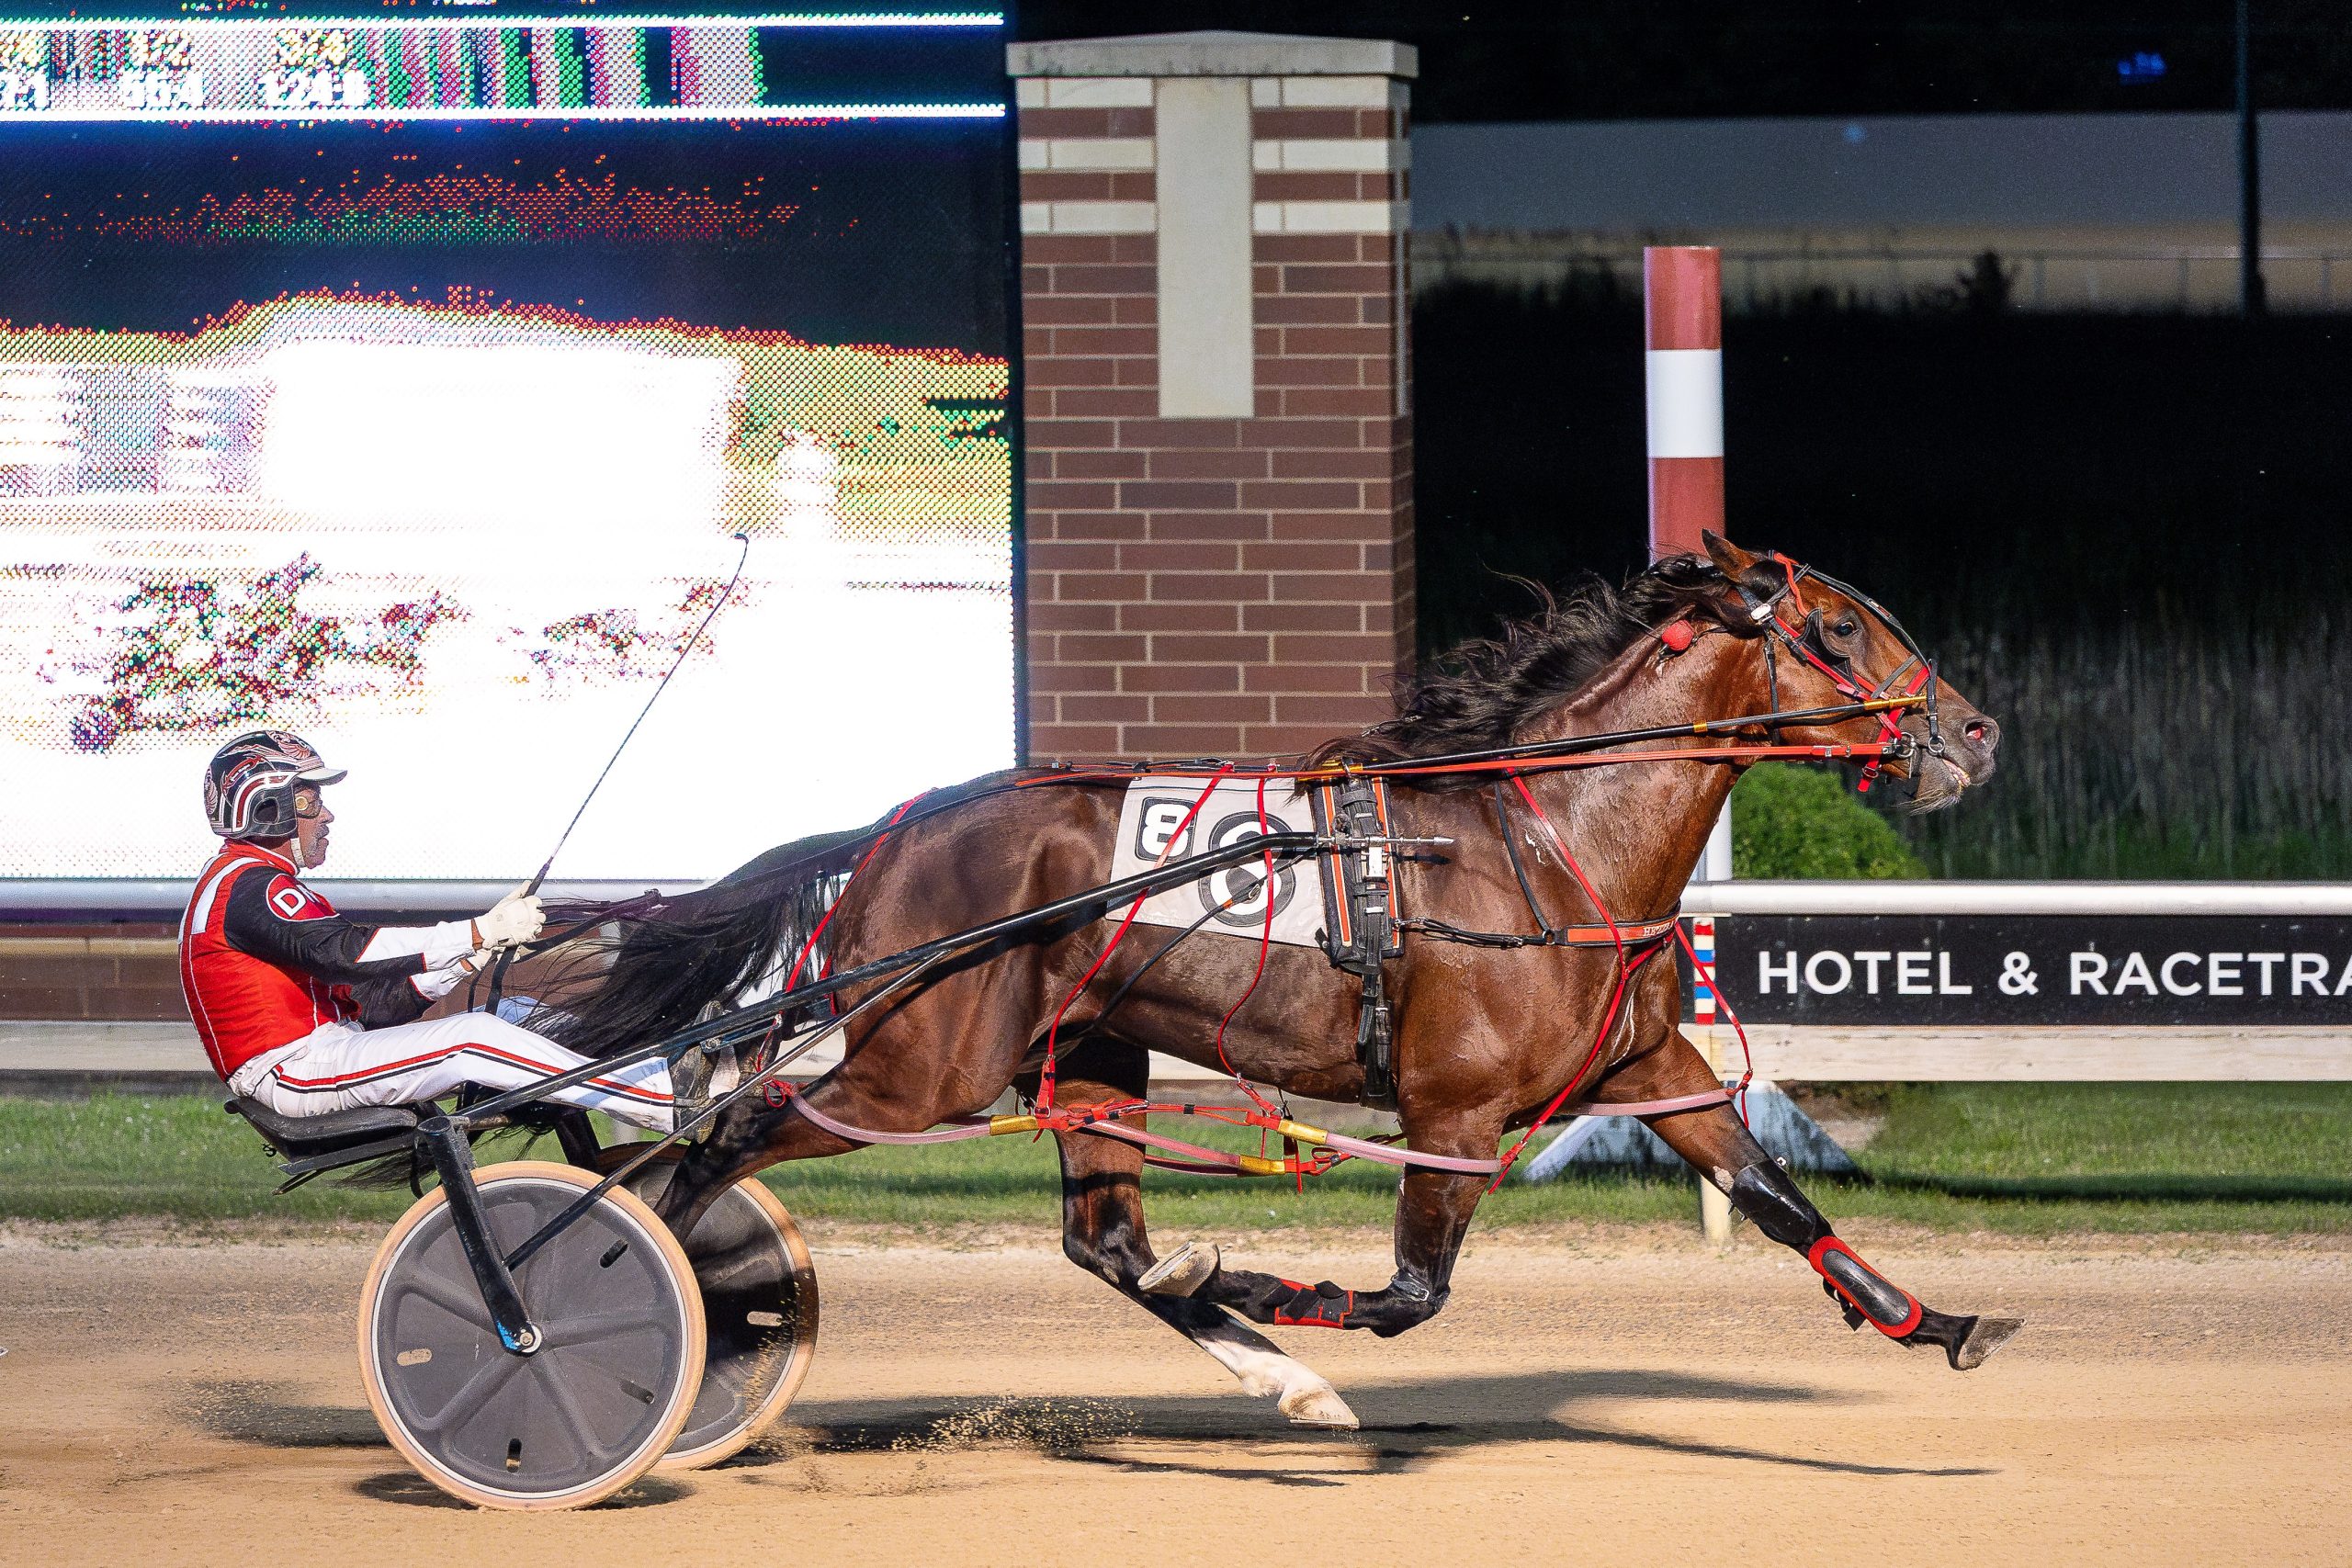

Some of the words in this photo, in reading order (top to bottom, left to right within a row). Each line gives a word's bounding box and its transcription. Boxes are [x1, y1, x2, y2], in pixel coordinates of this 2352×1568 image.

[1139, 802, 1192, 859] 8
[1758, 950, 1973, 995] HOTEL
[1997, 951, 2039, 995] &
